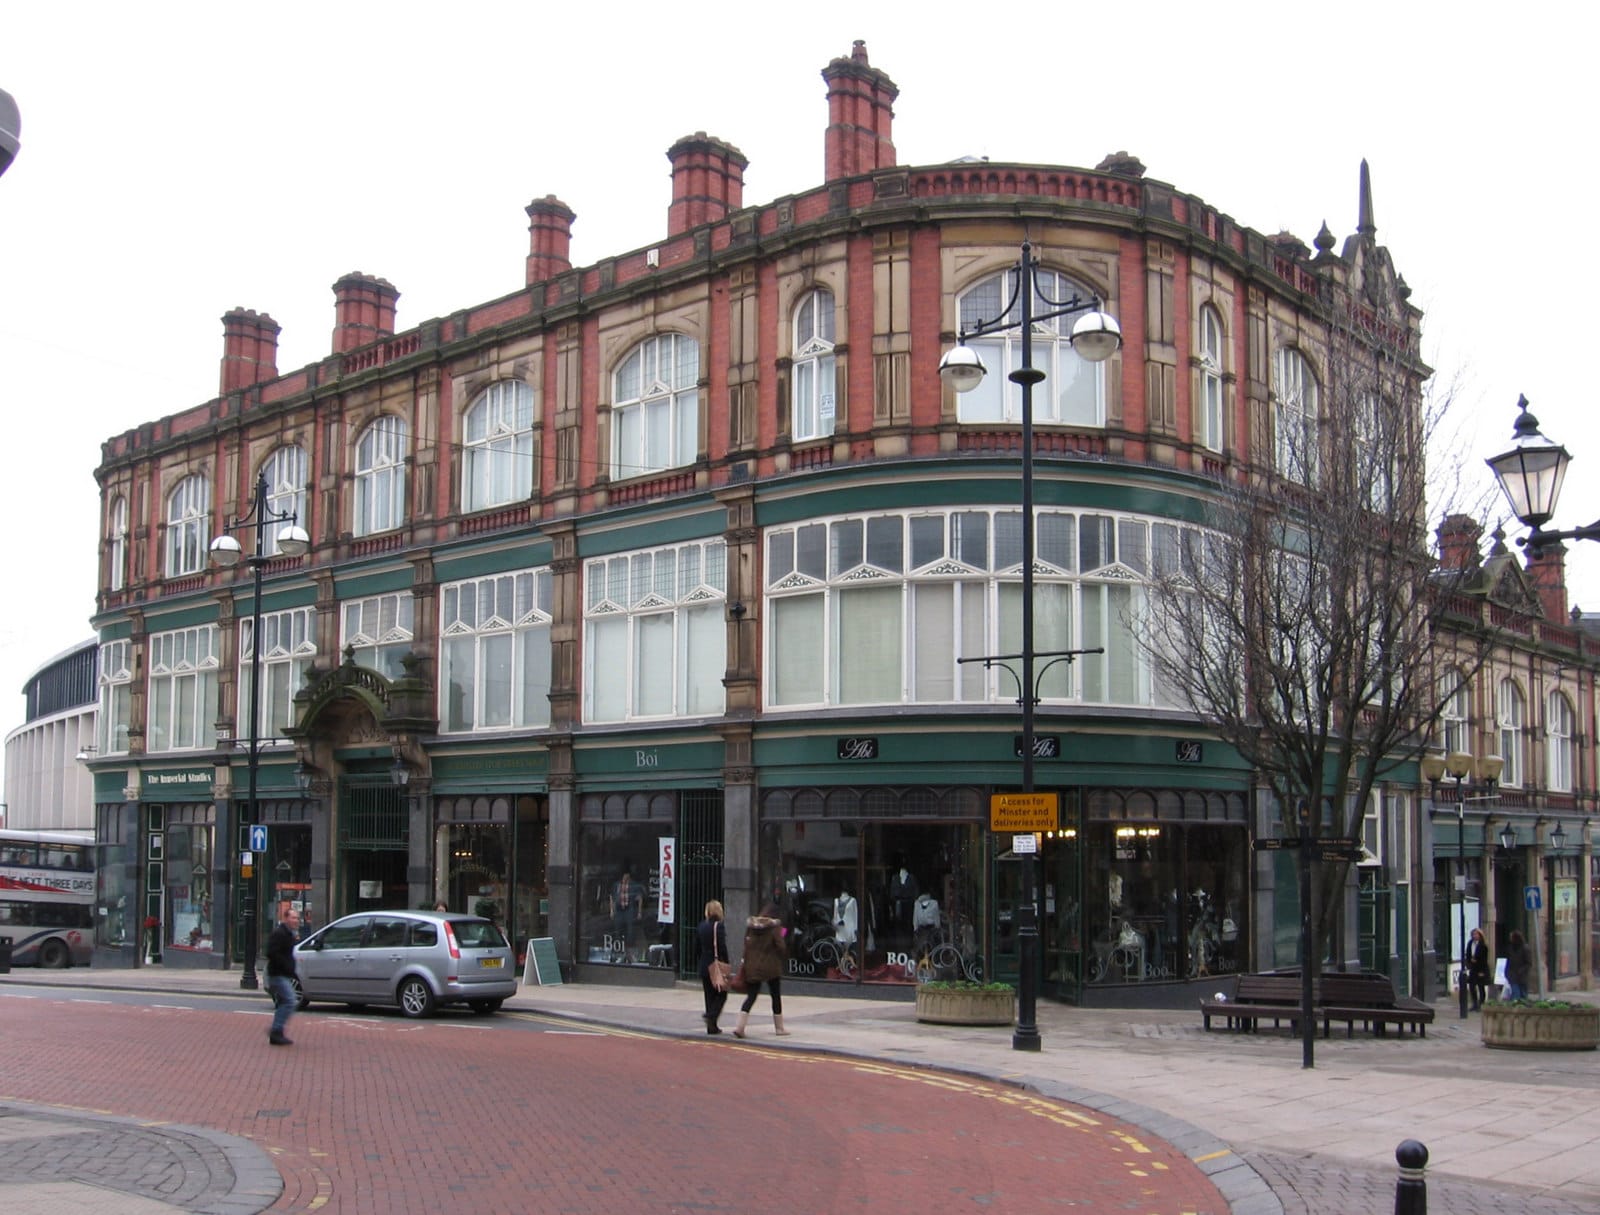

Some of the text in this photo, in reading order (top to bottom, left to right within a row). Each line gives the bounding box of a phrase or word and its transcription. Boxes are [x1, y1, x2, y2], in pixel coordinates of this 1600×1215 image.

[636, 749, 658, 767] Boi
[148, 774, 159, 784] The
[161, 773, 186, 784] Imperial
[1001, 797, 1044, 806] Access for
[999, 808, 1048, 816] Minster and
[994, 819, 1055, 828] deliveries only
[44, 878, 71, 889] THREE
[72, 880, 93, 890] DAYS
[662, 845, 672, 915] SALE
[603, 934, 625, 952] Boi
[788, 959, 814, 975] Boo
